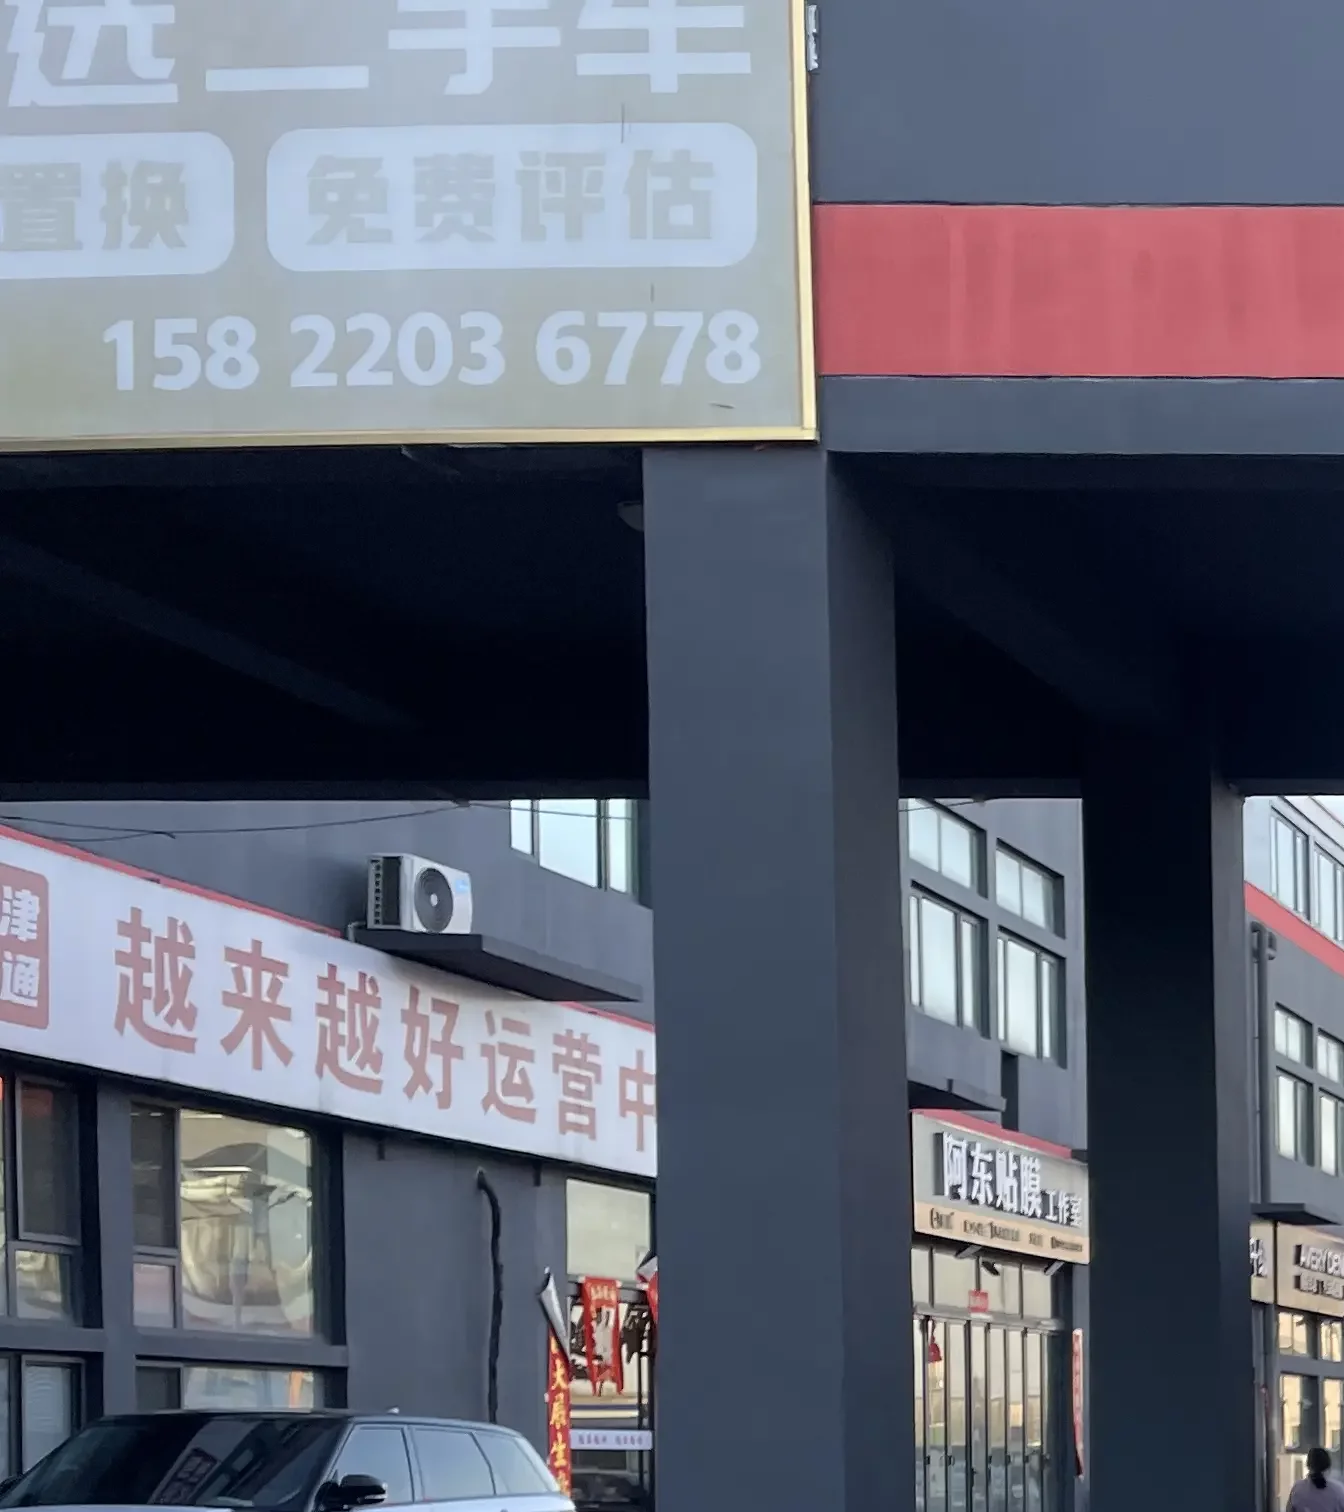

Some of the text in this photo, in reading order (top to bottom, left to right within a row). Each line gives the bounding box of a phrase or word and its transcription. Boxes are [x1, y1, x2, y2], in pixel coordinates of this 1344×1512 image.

[305, 148, 716, 246] 免费评估
[103, 310, 762, 392] 158 2203 6778
[113, 905, 656, 1153] 越来越好运营中
